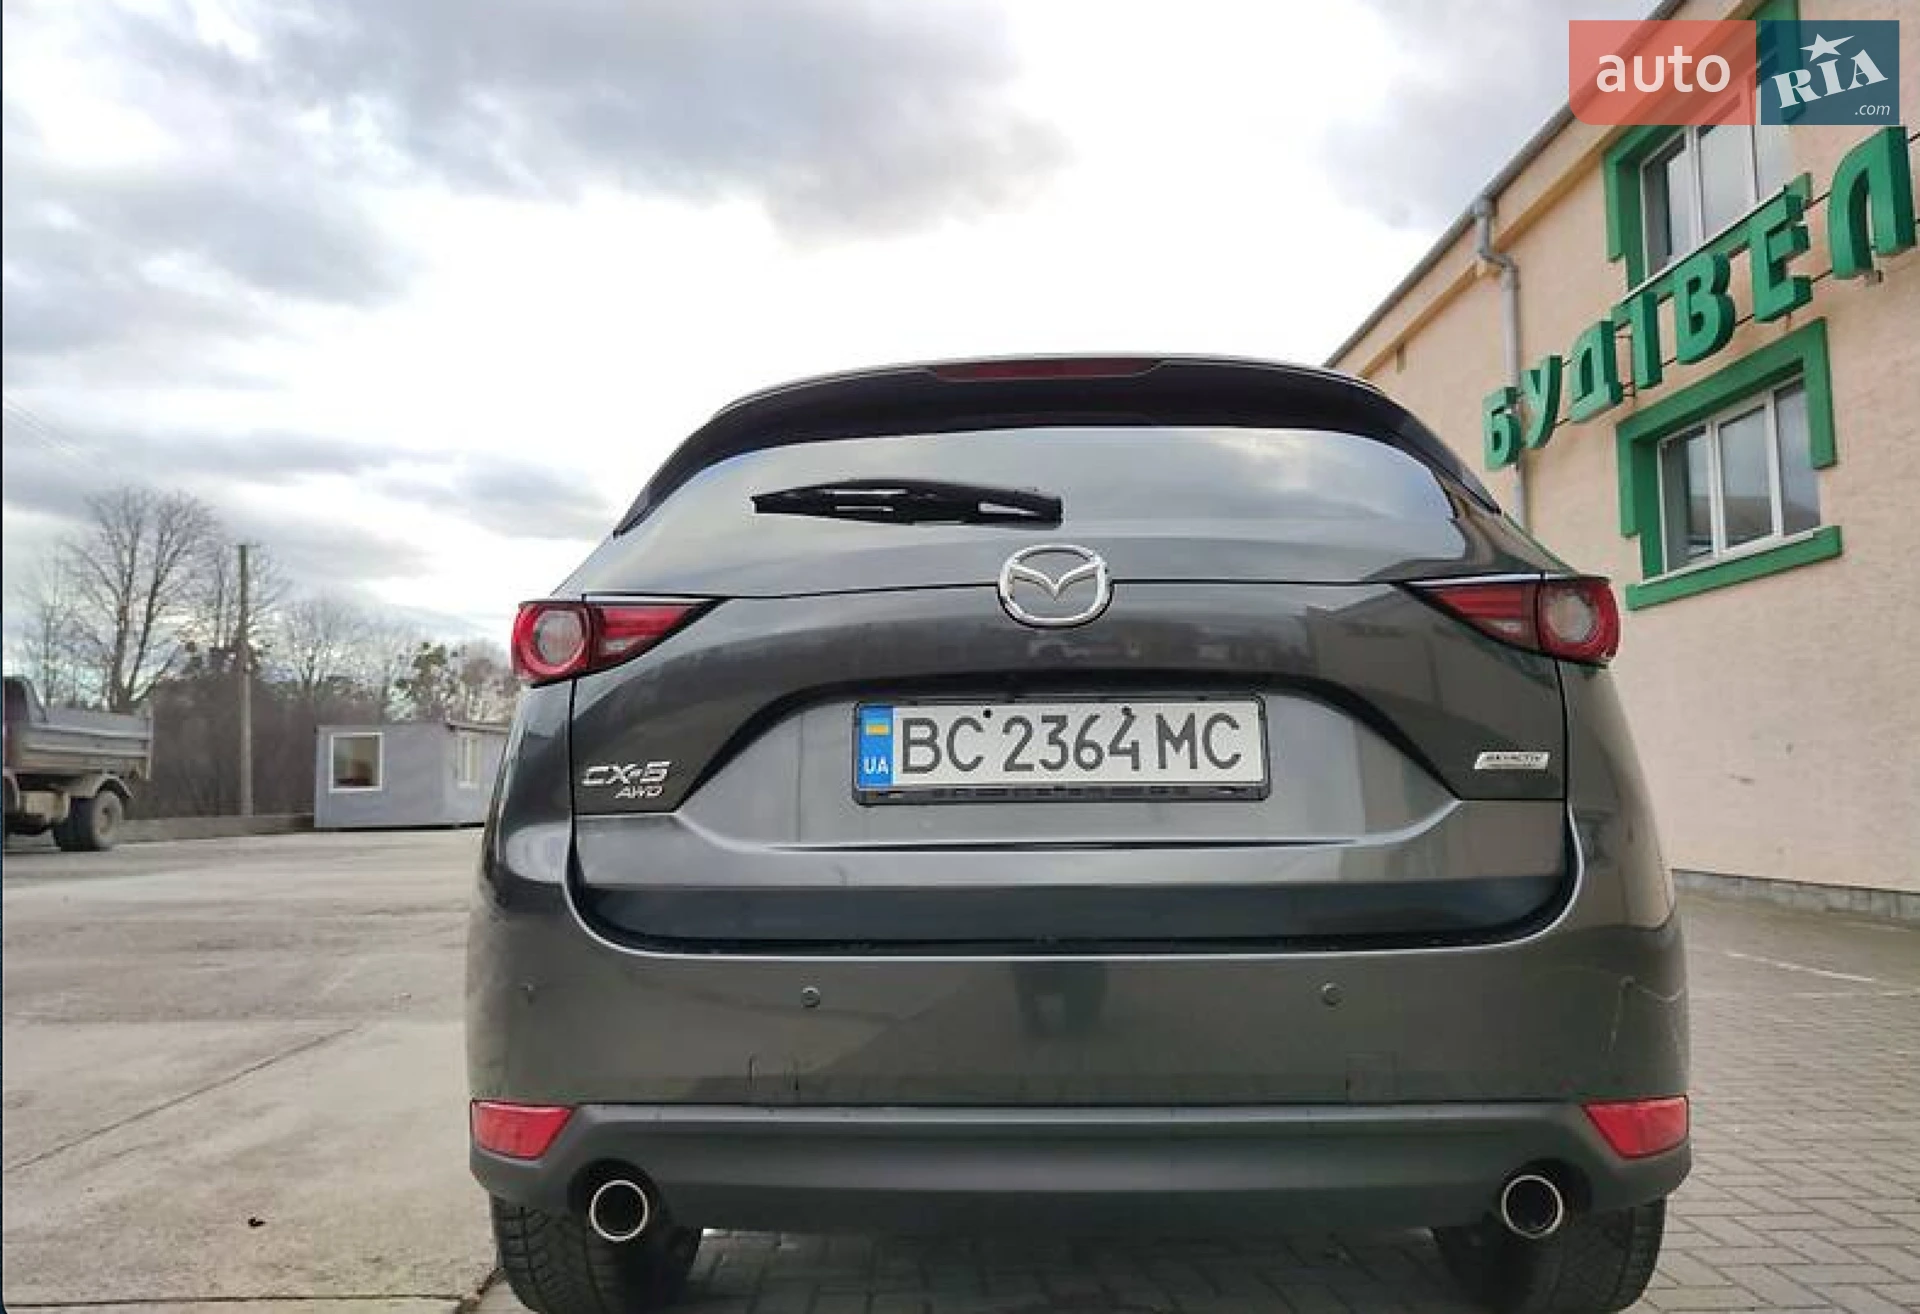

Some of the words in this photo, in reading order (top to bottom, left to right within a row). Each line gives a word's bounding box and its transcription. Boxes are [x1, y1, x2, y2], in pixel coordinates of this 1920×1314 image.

[1001, 714, 1140, 772] 2364
[582, 761, 671, 786] CX-5
[864, 759, 889, 775] UA
